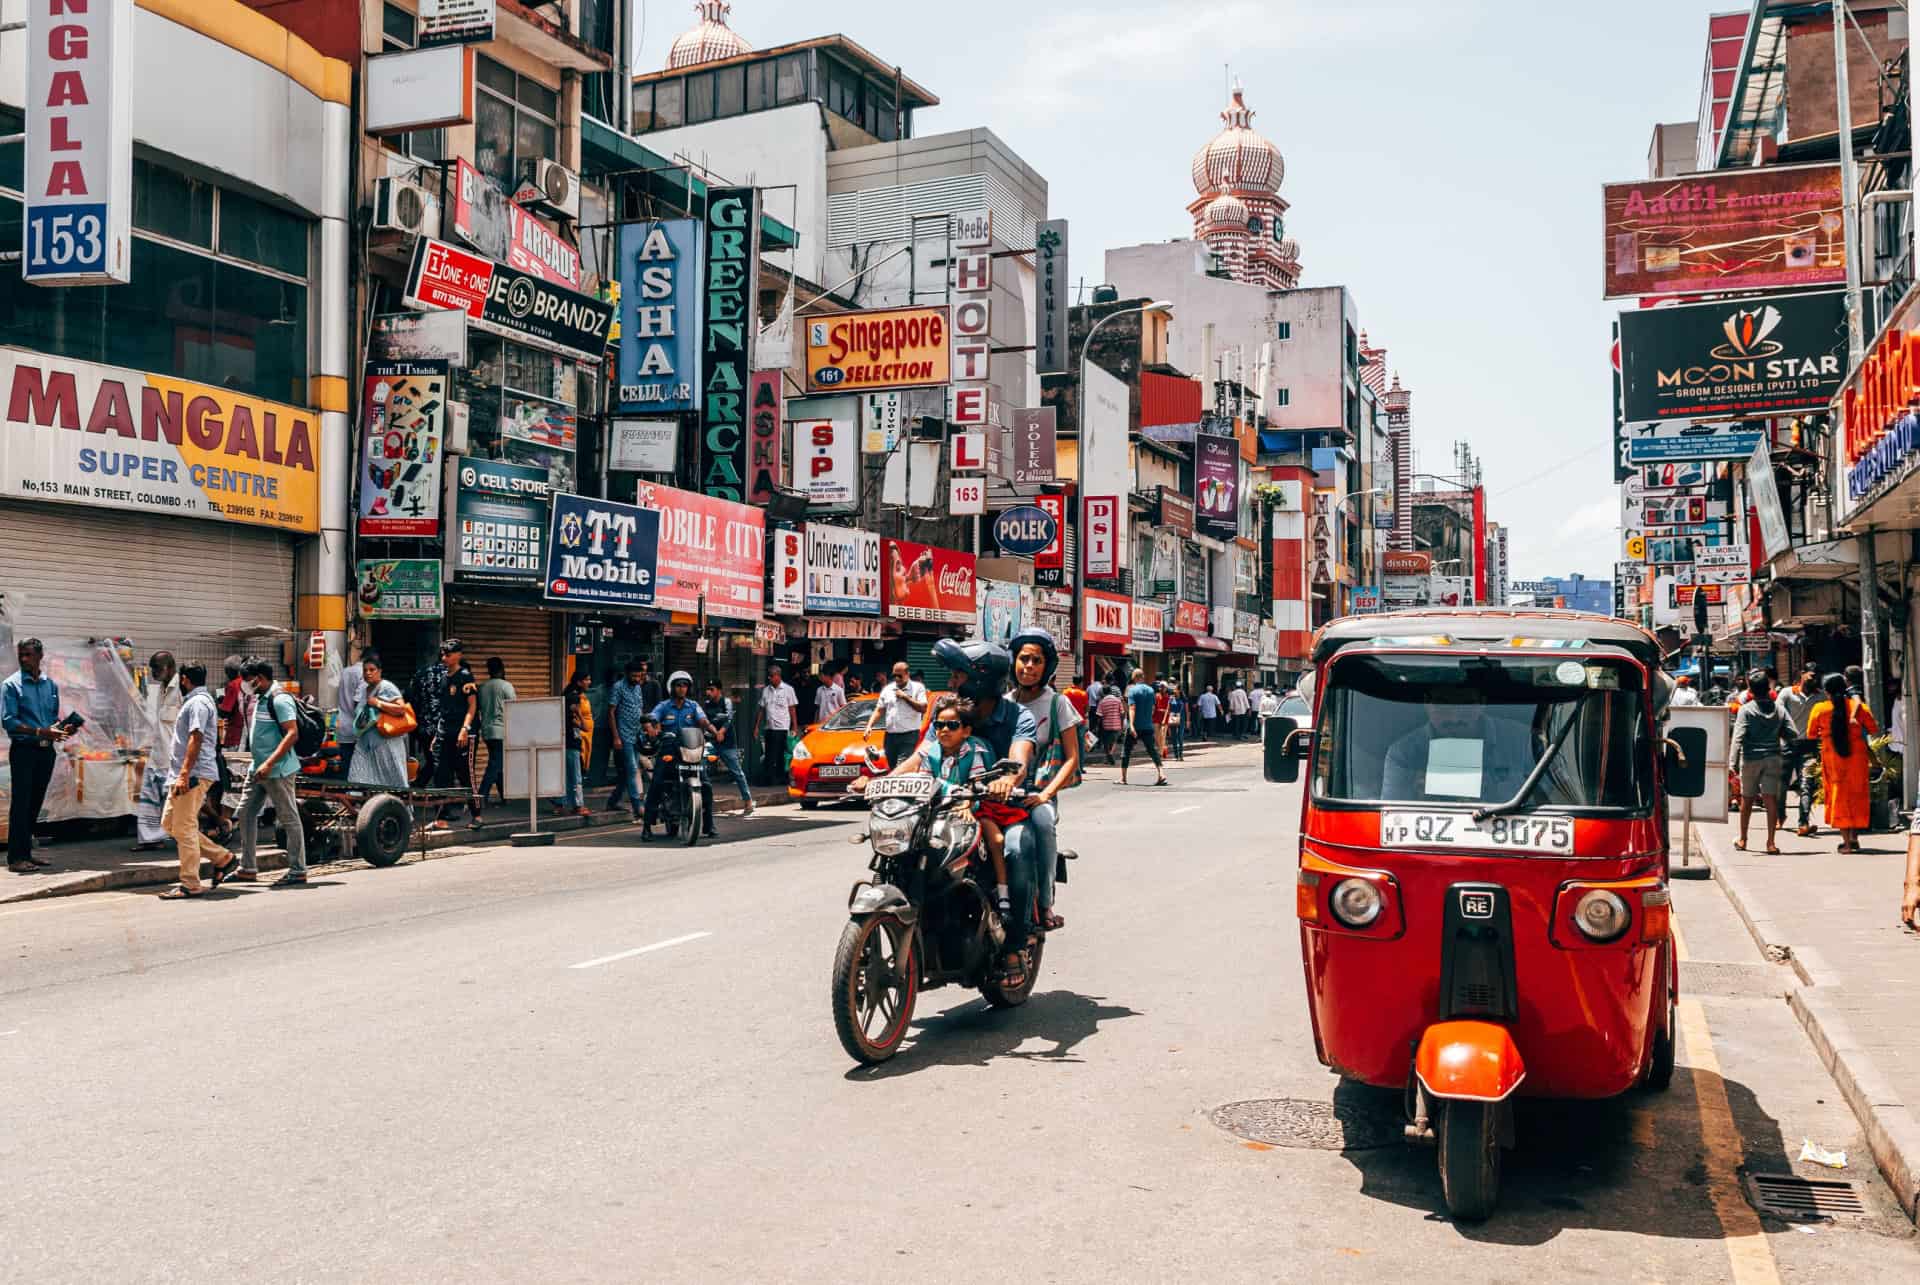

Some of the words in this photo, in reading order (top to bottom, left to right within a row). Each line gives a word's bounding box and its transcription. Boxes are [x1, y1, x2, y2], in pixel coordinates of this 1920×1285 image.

[515, 189, 535, 201] 155
[1623, 184, 1717, 217] Aadil
[31, 214, 102, 267] 153
[522, 216, 577, 285] ARCADE
[443, 265, 460, 285] ONE
[469, 273, 488, 294] ONE
[707, 197, 747, 352] GREEN
[533, 291, 607, 336] BRANDZ
[637, 229, 676, 376] ASHA
[828, 315, 943, 365] Singapore
[820, 370, 839, 382] 161
[845, 361, 933, 383] SELECTION
[955, 257, 987, 467] HOTEL
[1657, 361, 1755, 388] MOON
[1766, 356, 1840, 378] STAR
[1676, 387, 1711, 397] GROOM
[1714, 383, 1763, 395] DESIGNER
[1800, 378, 1819, 388] LTD
[7, 364, 315, 472] MANGALA
[753, 382, 777, 494] ASHA
[1027, 423, 1041, 468] POLEK
[79, 448, 178, 484] SUPER
[190, 464, 279, 500] CENTRE
[479, 473, 508, 490] CELL
[511, 478, 549, 495] STORE
[64, 484, 90, 497] MAIN
[137, 492, 181, 507] COLOMBO
[955, 487, 978, 502] 163
[585, 509, 637, 559] TT
[725, 520, 765, 561] CITY
[1000, 519, 1048, 542] POLEK
[1093, 504, 1109, 553] DSI
[807, 531, 860, 571] Univercell
[864, 540, 878, 572] OG
[560, 554, 650, 586] Mobile
[898, 607, 921, 619] BEE
[925, 609, 947, 620] BEE
[1356, 597, 1377, 608] BEST
[1415, 816, 1454, 842] QZ
[1491, 818, 1569, 848] 8075
[1465, 900, 1488, 914] RE
